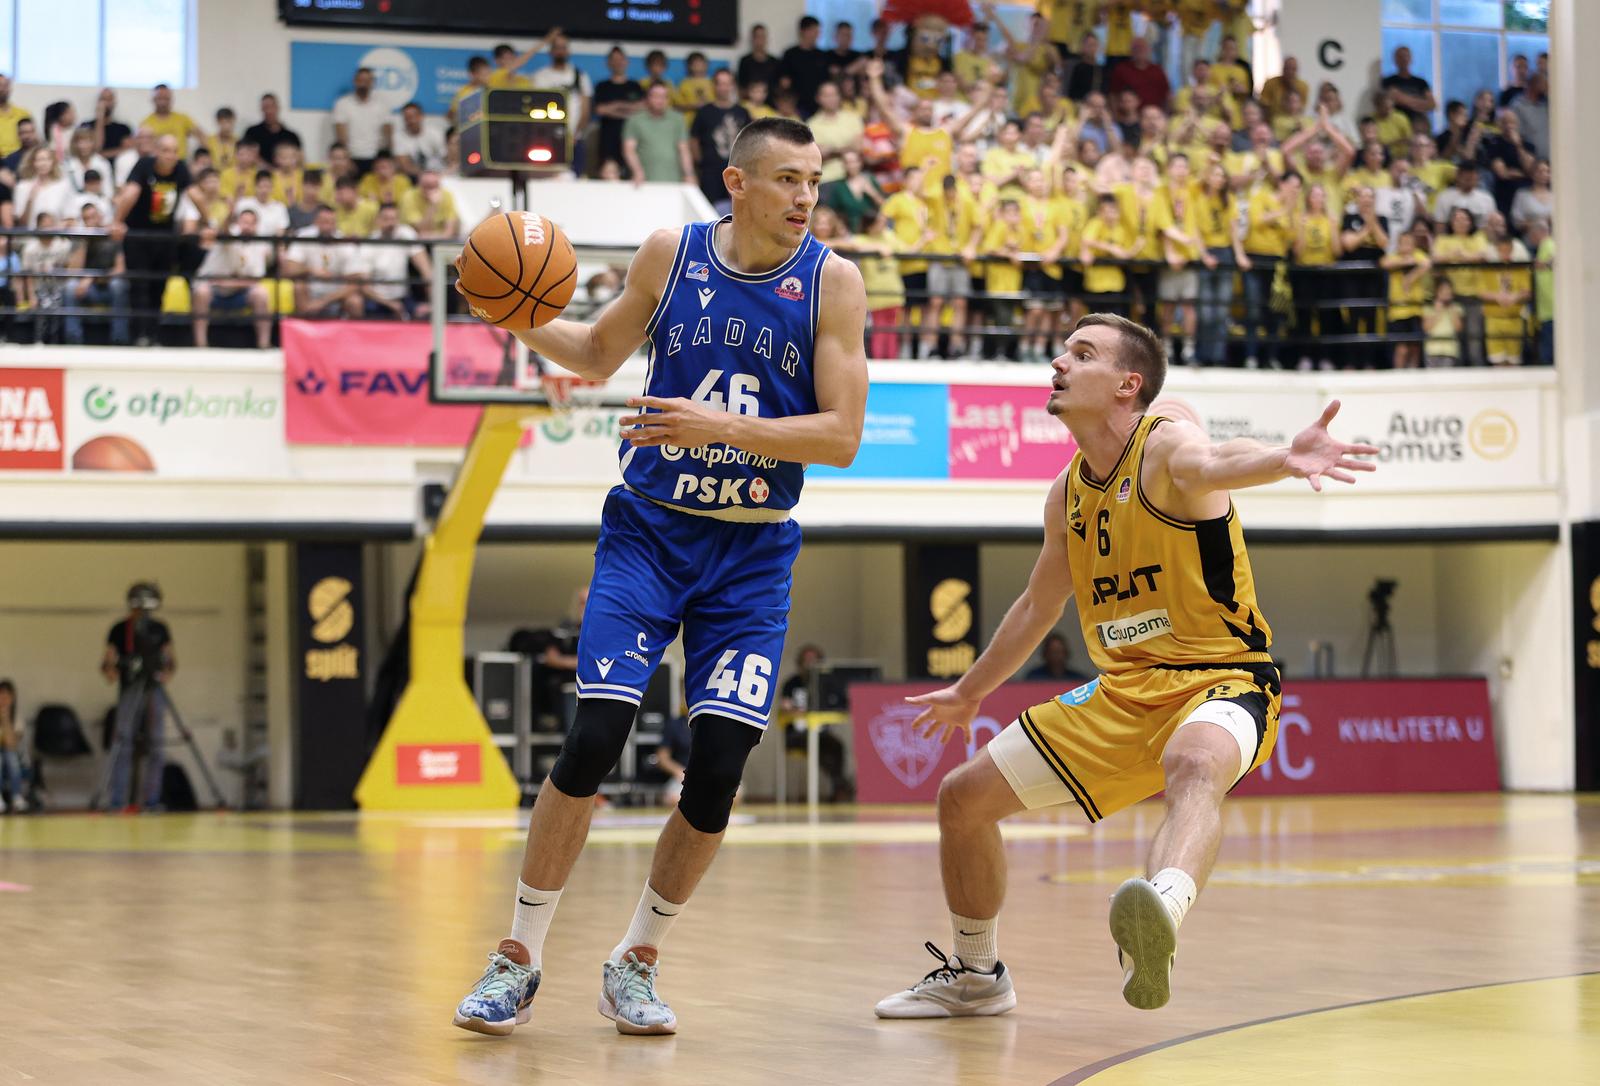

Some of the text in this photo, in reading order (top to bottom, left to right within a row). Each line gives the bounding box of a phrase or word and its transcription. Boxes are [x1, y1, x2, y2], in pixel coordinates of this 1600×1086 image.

[1317, 38, 1344, 70] C
[667, 317, 800, 377] ZADAR
[340, 371, 430, 395] FAV
[690, 369, 761, 418] 46
[127, 385, 277, 423] otpbanka
[948, 402, 1014, 430] Last
[1388, 410, 1463, 438] Auro
[672, 473, 747, 505] PSK
[1097, 509, 1111, 557] 6
[1092, 564, 1163, 606] PLIT
[705, 649, 772, 708] 46
[1337, 716, 1484, 743] KVALITETA U
